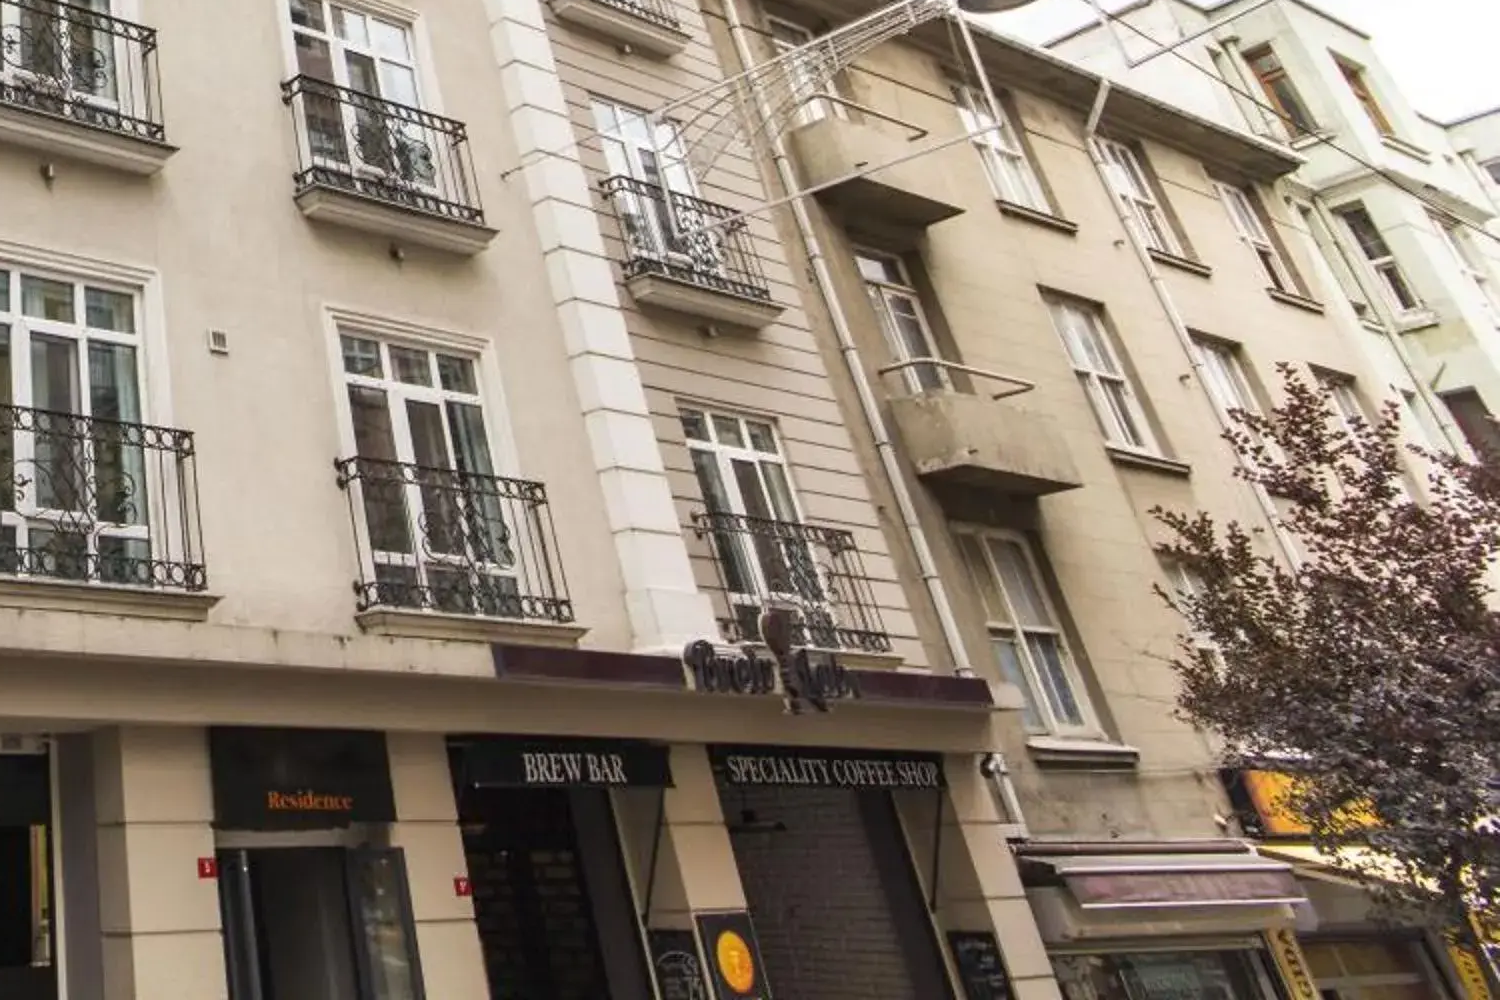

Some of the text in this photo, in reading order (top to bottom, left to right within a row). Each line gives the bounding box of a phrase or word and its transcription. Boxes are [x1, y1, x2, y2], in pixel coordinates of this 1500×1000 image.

[523, 752, 628, 784] BREW BAR
[727, 756, 832, 785] SPECIALITY
[833, 759, 899, 786] COFFEE
[268, 789, 353, 810] Residence
